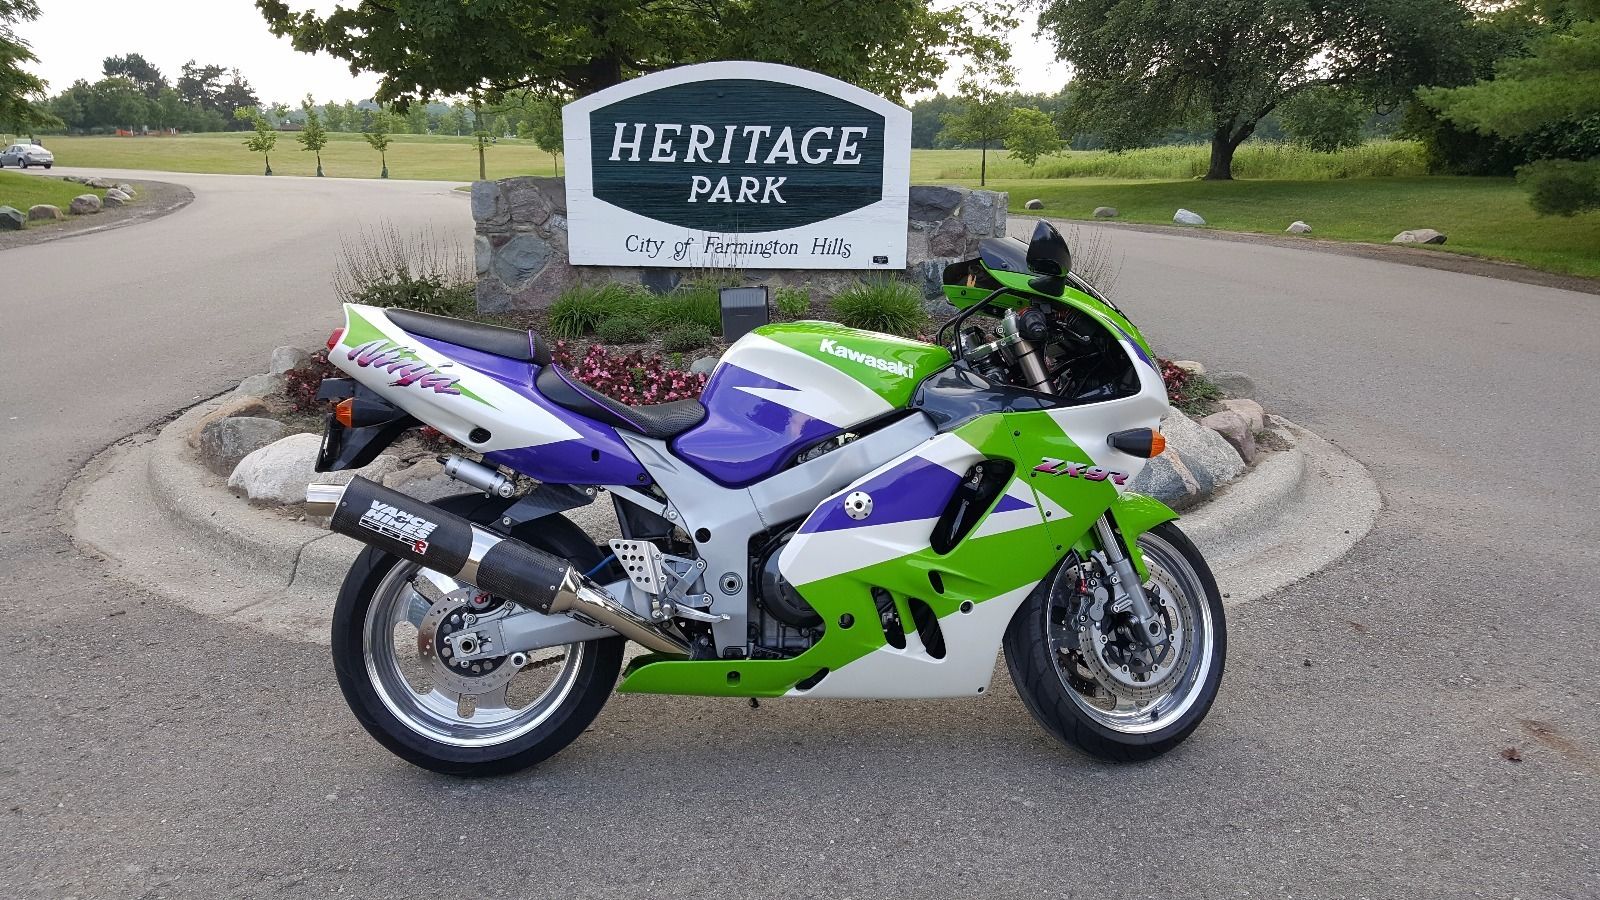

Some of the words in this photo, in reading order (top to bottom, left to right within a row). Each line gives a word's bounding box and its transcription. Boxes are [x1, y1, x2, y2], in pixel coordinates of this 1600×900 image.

[608, 122, 867, 164] HERITAGE
[687, 176, 787, 204] PARK
[625, 234, 665, 259] City
[673, 237, 695, 261] of
[703, 236, 799, 259] Farmington
[810, 237, 852, 259] Hills
[347, 338, 461, 395] Ninja
[819, 338, 914, 379] Kawasaki
[364, 508, 428, 539] HINES
[370, 500, 438, 534] VANCE
